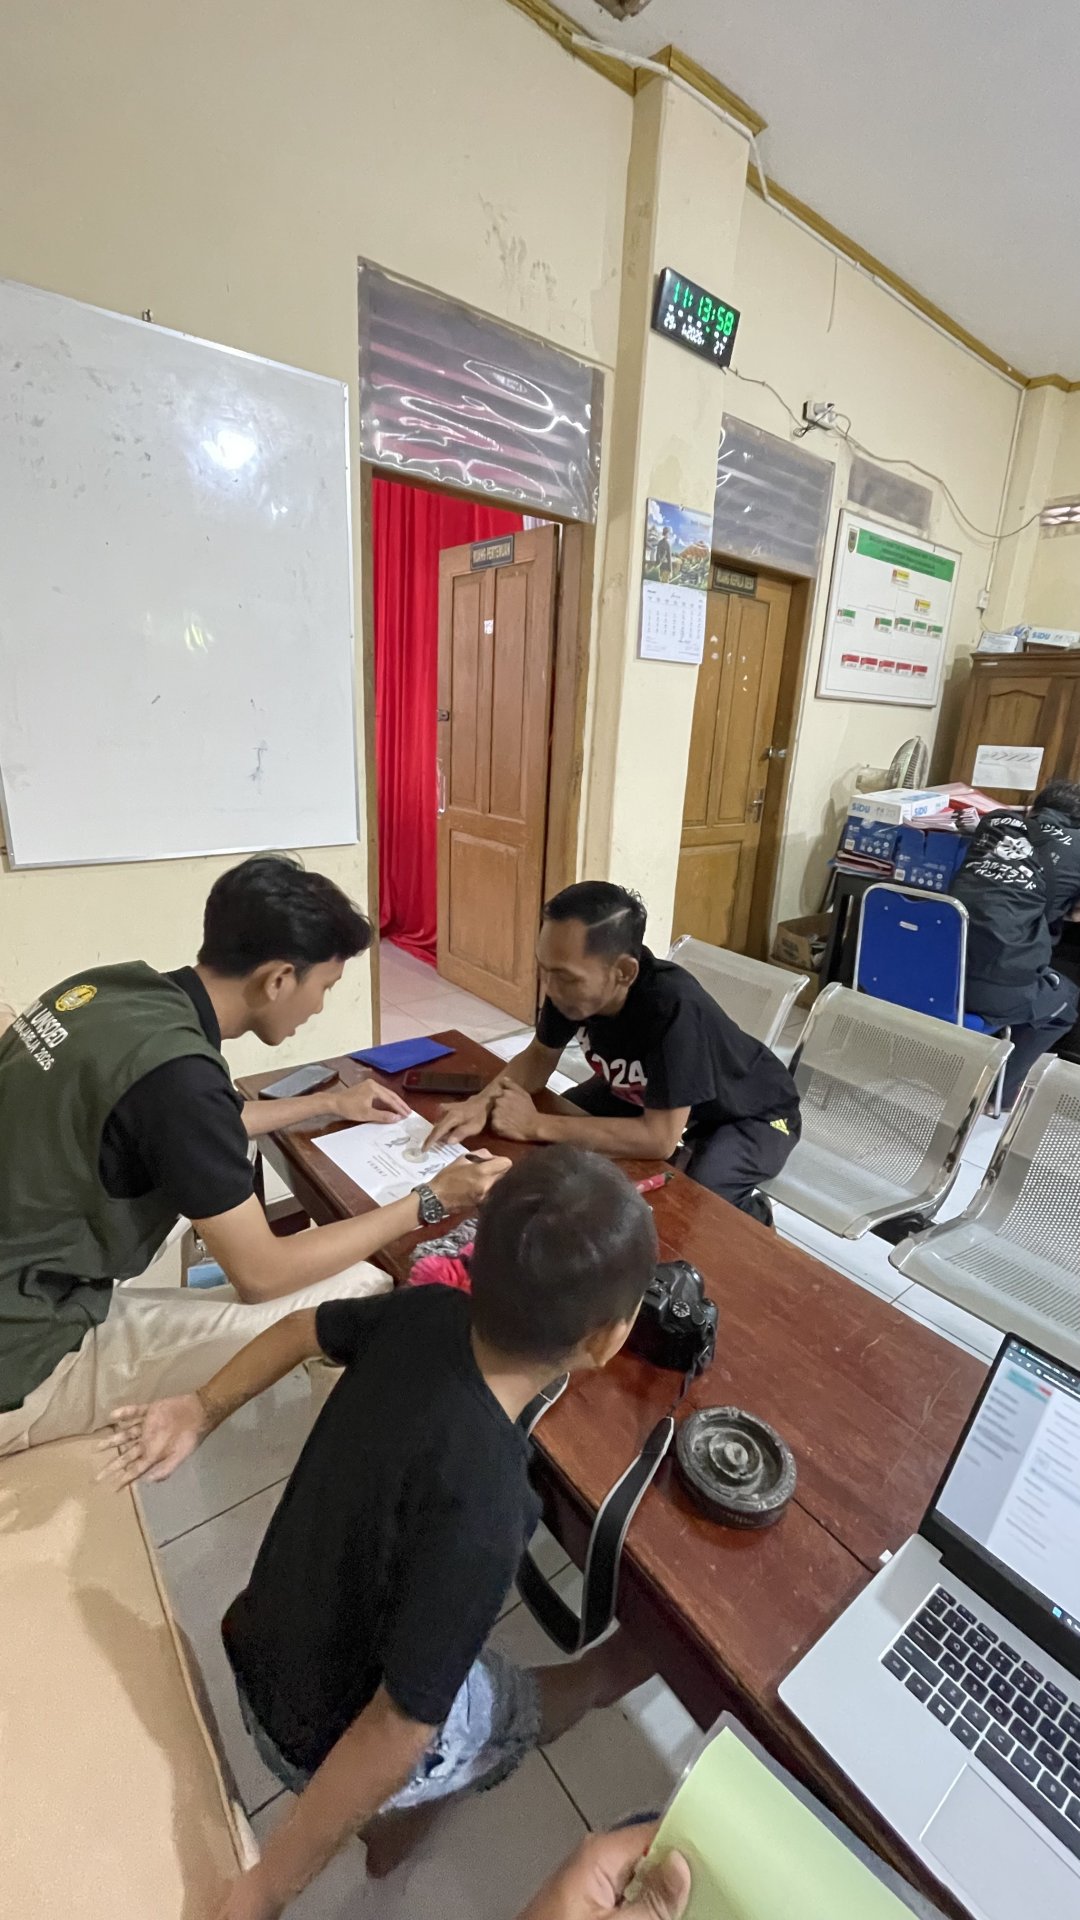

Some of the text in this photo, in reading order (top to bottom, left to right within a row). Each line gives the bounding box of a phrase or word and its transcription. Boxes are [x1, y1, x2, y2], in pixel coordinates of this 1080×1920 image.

[673, 281, 734, 336] 11:13:58
[31, 1007, 68, 1048] UNSOED
[33, 1047, 55, 1071] 2026
